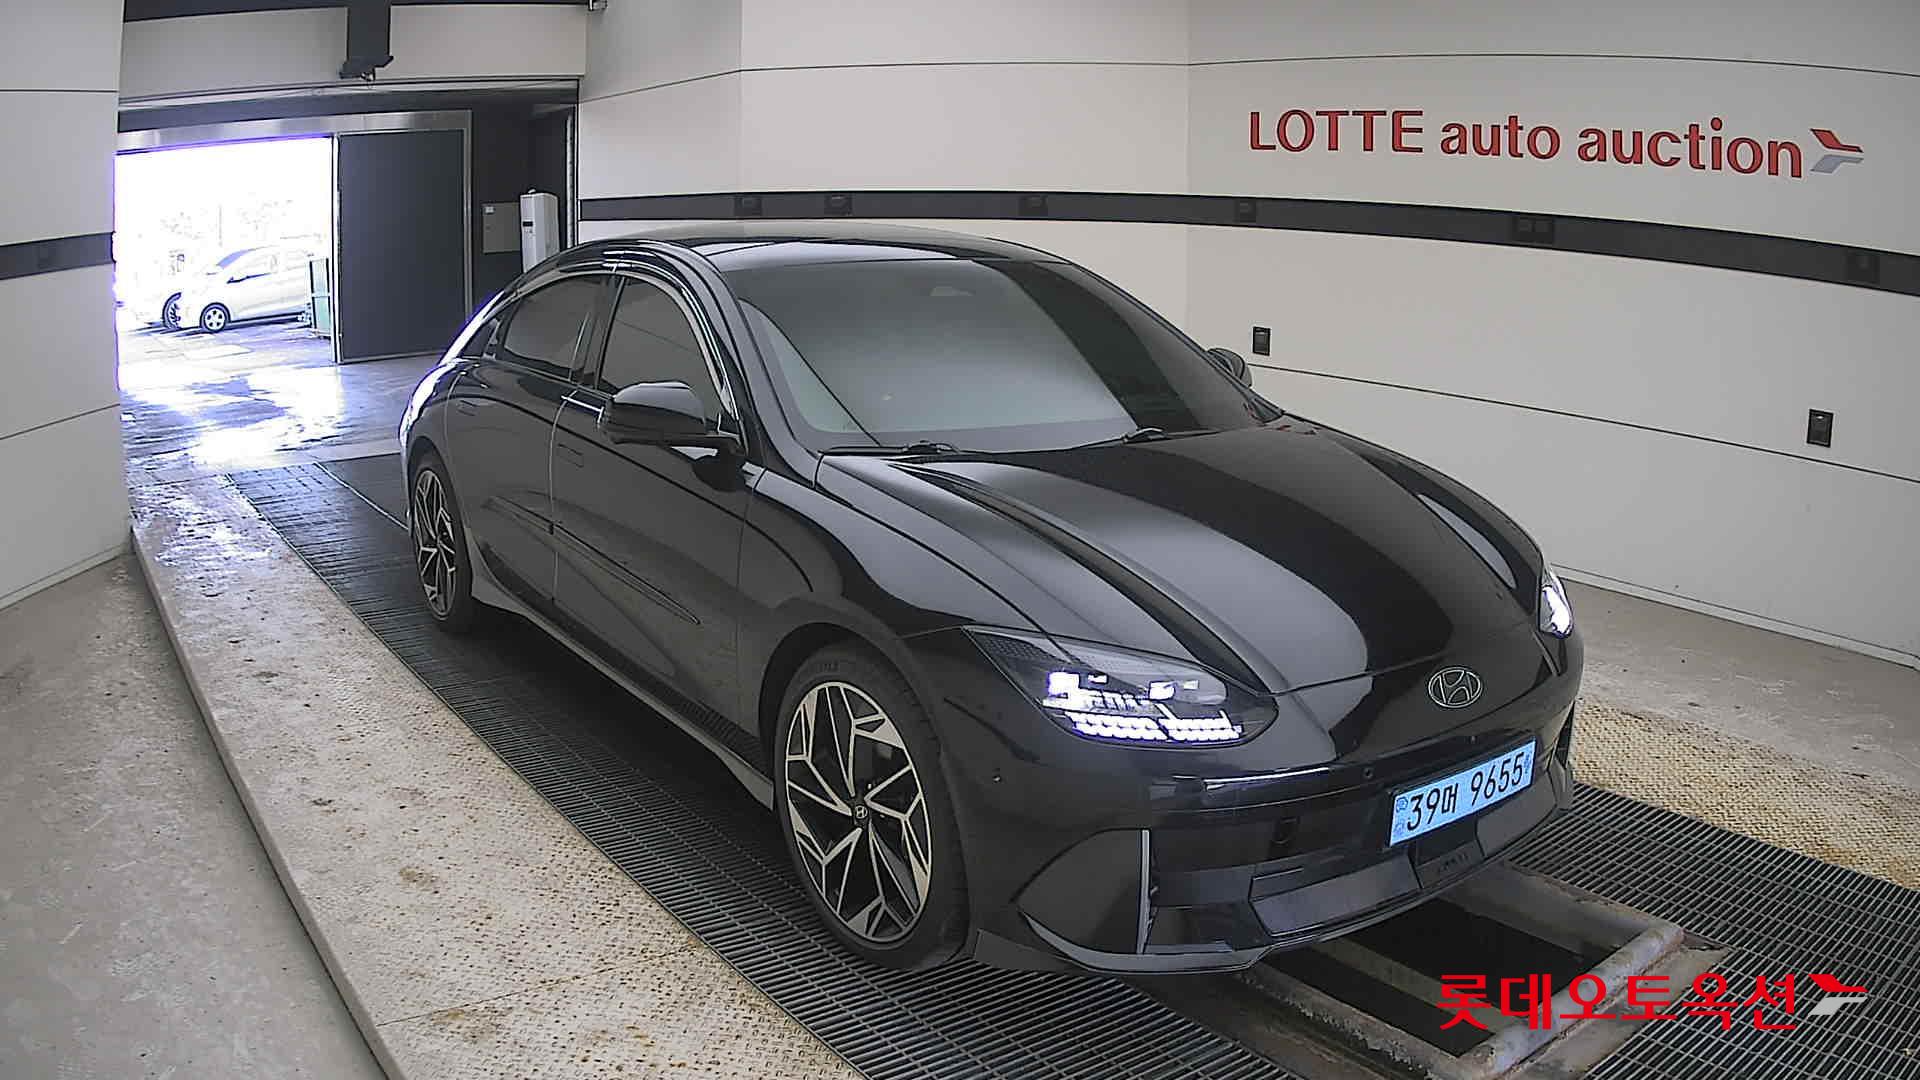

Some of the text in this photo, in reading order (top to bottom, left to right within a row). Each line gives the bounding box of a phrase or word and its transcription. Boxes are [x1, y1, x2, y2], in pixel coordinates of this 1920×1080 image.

[1248, 110, 1803, 179] LOTTE auto auction
[1406, 783, 1459, 831] 39머
[1470, 752, 1525, 806] 9655
